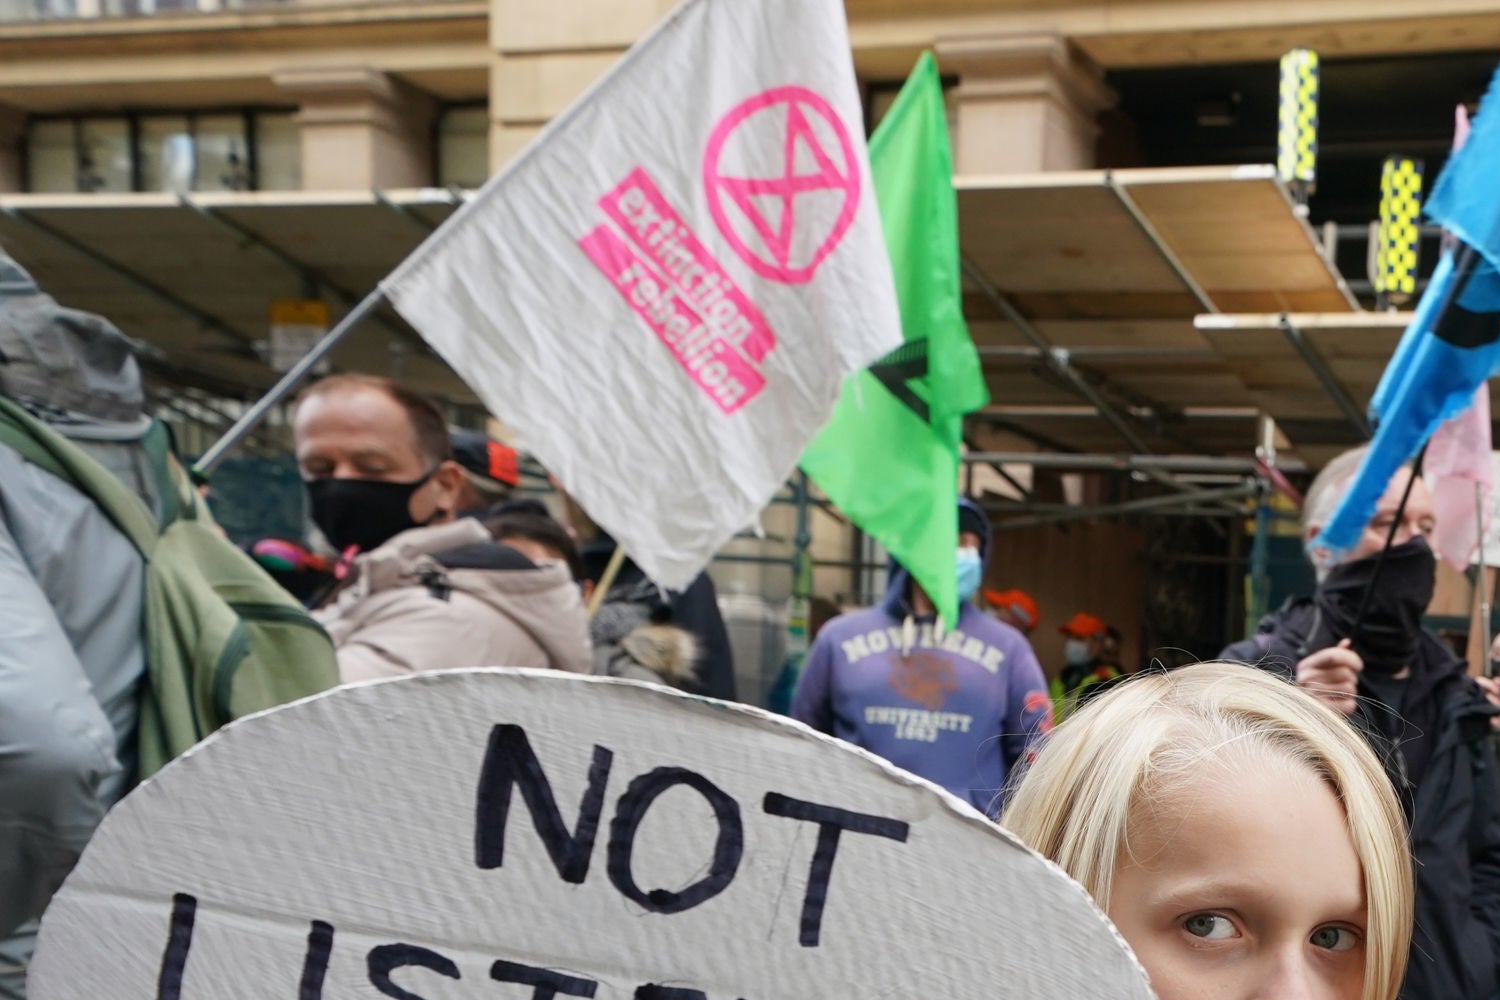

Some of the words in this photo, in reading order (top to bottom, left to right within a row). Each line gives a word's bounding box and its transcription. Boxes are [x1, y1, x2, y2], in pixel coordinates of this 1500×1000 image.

[617, 185, 752, 346] extinction
[619, 259, 747, 407] rebellion
[864, 705, 973, 733] UNIVERSITY
[474, 722, 910, 948] NOT
